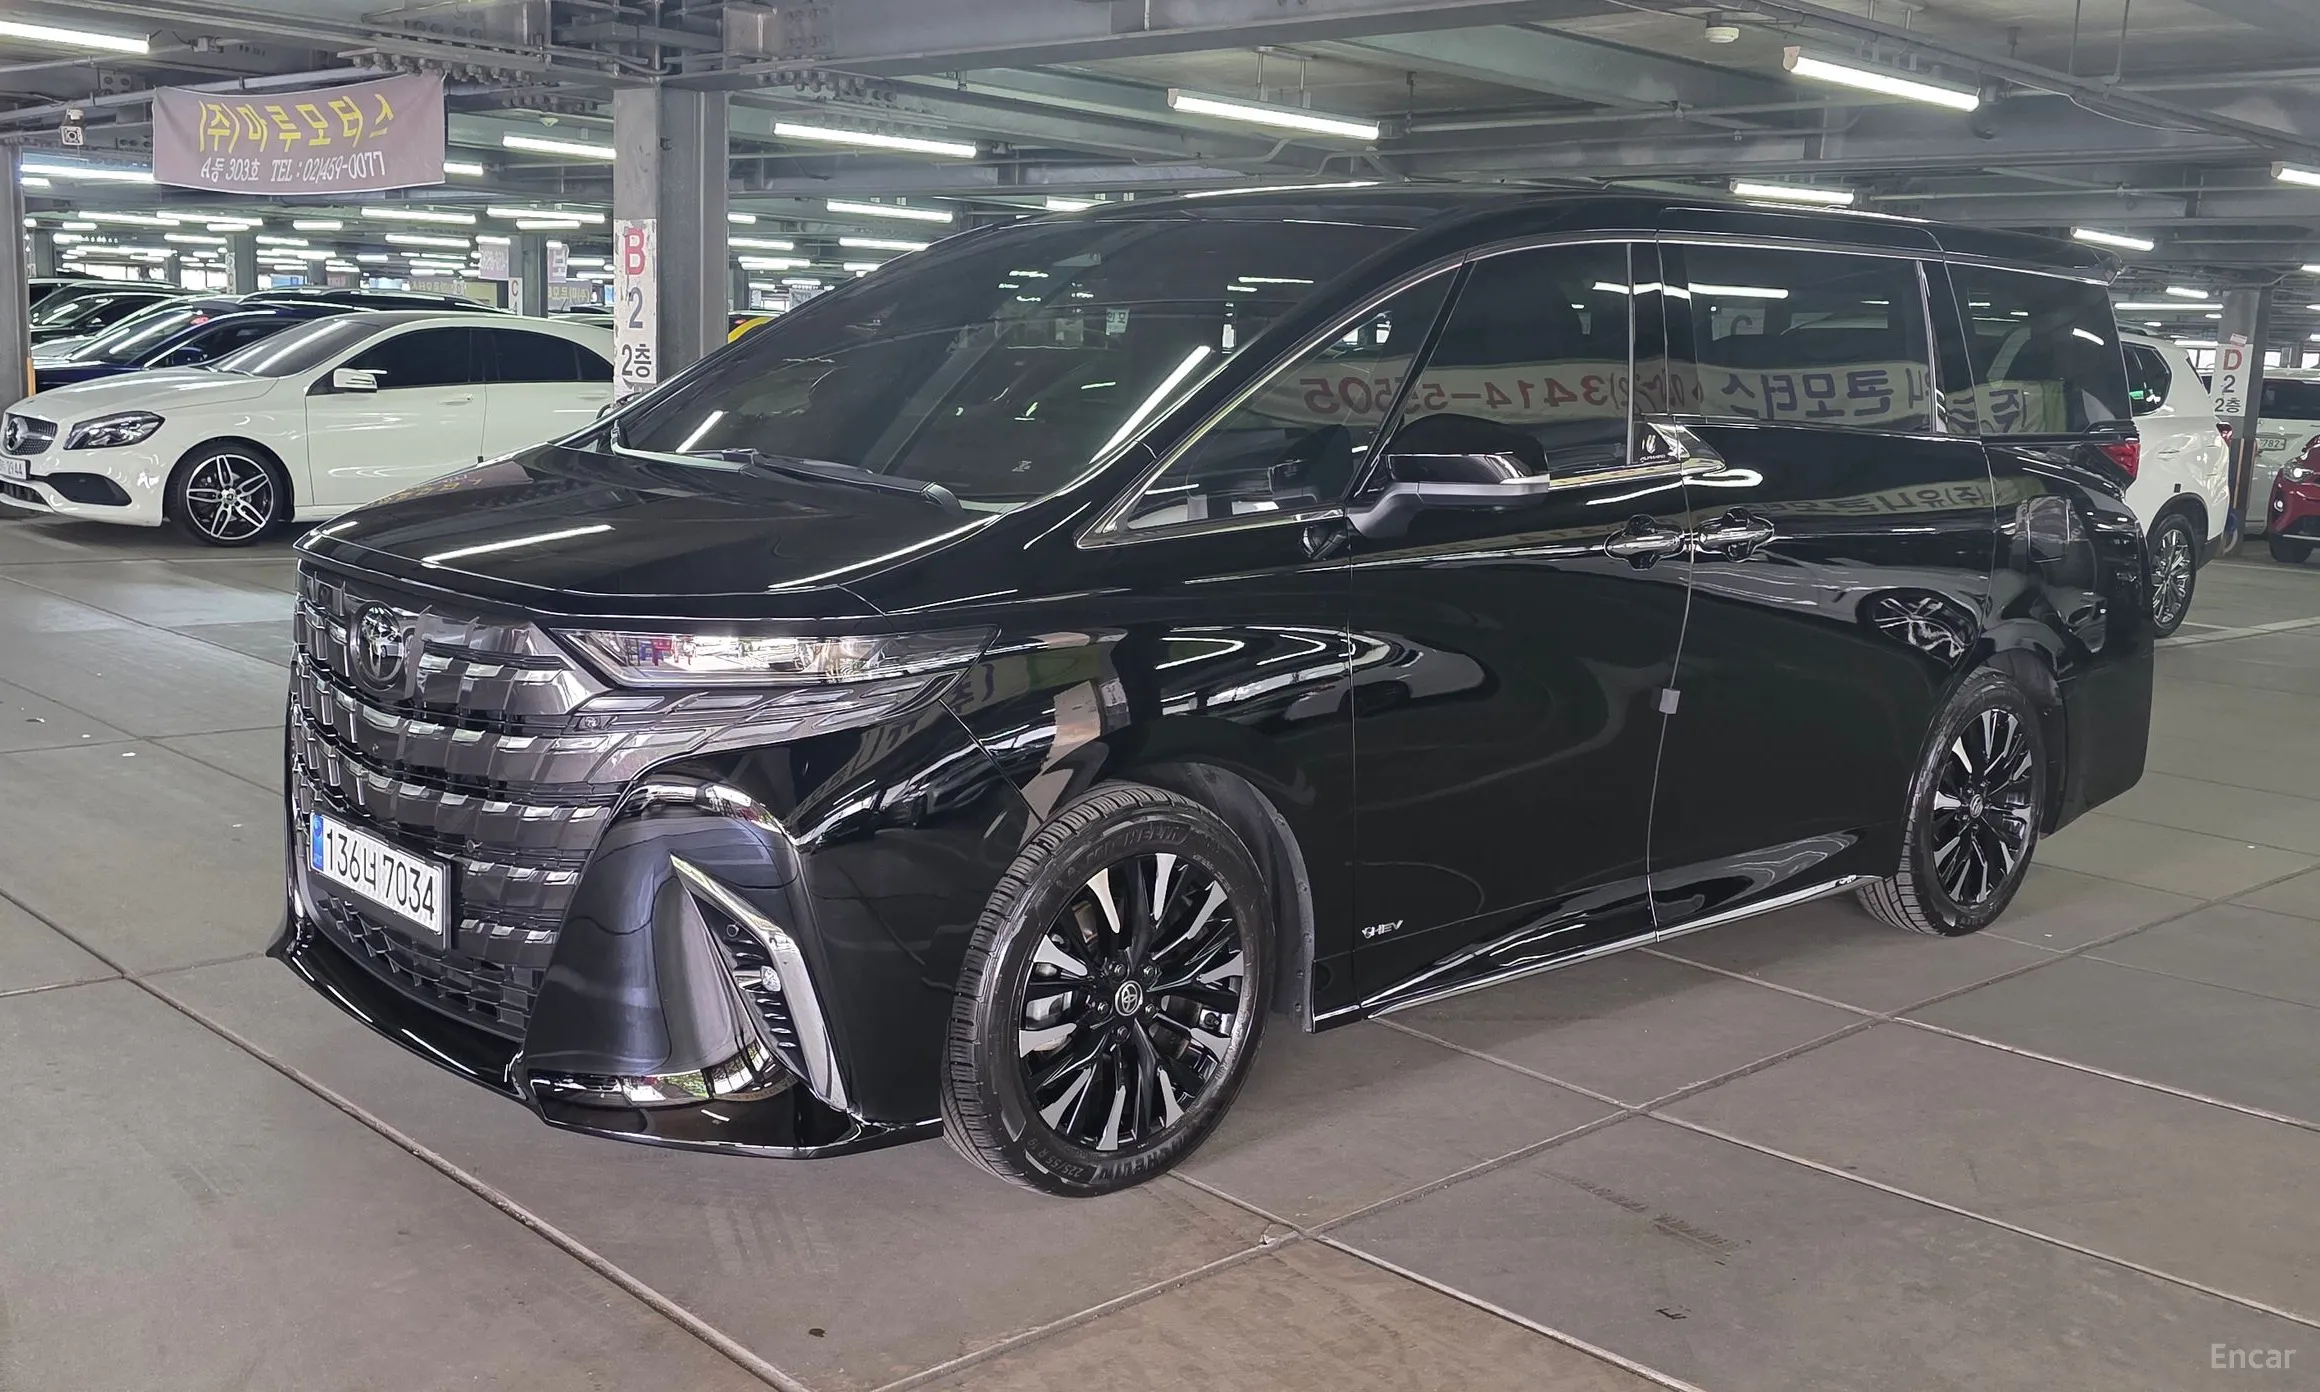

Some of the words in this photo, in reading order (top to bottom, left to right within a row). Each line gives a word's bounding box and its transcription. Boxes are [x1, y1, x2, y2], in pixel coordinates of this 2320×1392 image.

[199, 93, 394, 153] (주)마루모터스
[201, 157, 224, 183] A동
[226, 158, 261, 181] 303호
[624, 227, 646, 276] B
[628, 286, 644, 329] 2
[621, 343, 651, 378] 2층
[2222, 348, 2243, 371] D
[2222, 374, 2236, 393] 2
[2214, 397, 2241, 413] 2층
[326, 828, 377, 891] 136너
[383, 854, 435, 921] 7034
